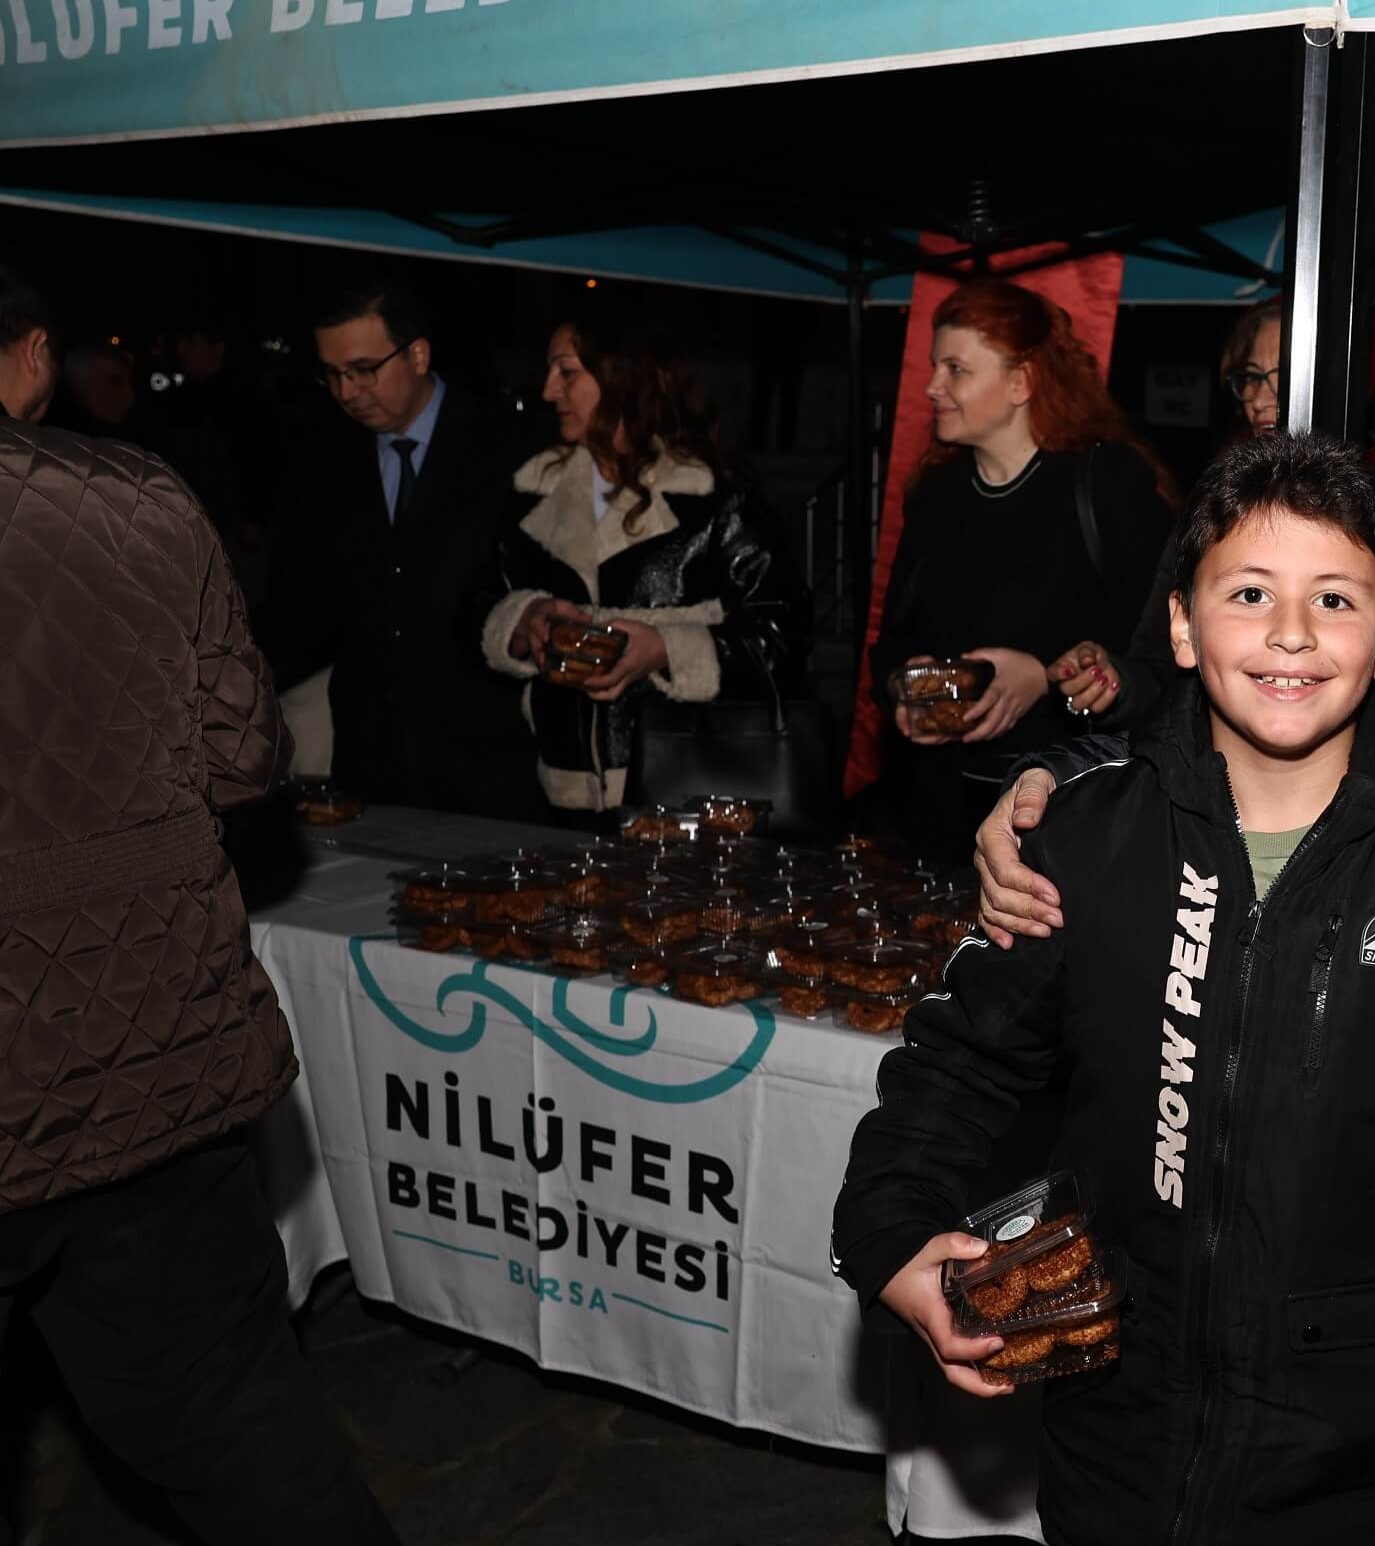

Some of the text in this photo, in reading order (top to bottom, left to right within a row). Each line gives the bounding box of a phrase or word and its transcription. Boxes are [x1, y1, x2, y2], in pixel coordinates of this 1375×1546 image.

[1153, 860, 1219, 1209] SNOW PEAK
[385, 1070, 739, 1225] NİLÜFER
[387, 1160, 730, 1302] BELEDİYESİ
[508, 1259, 609, 1315] BURSA
